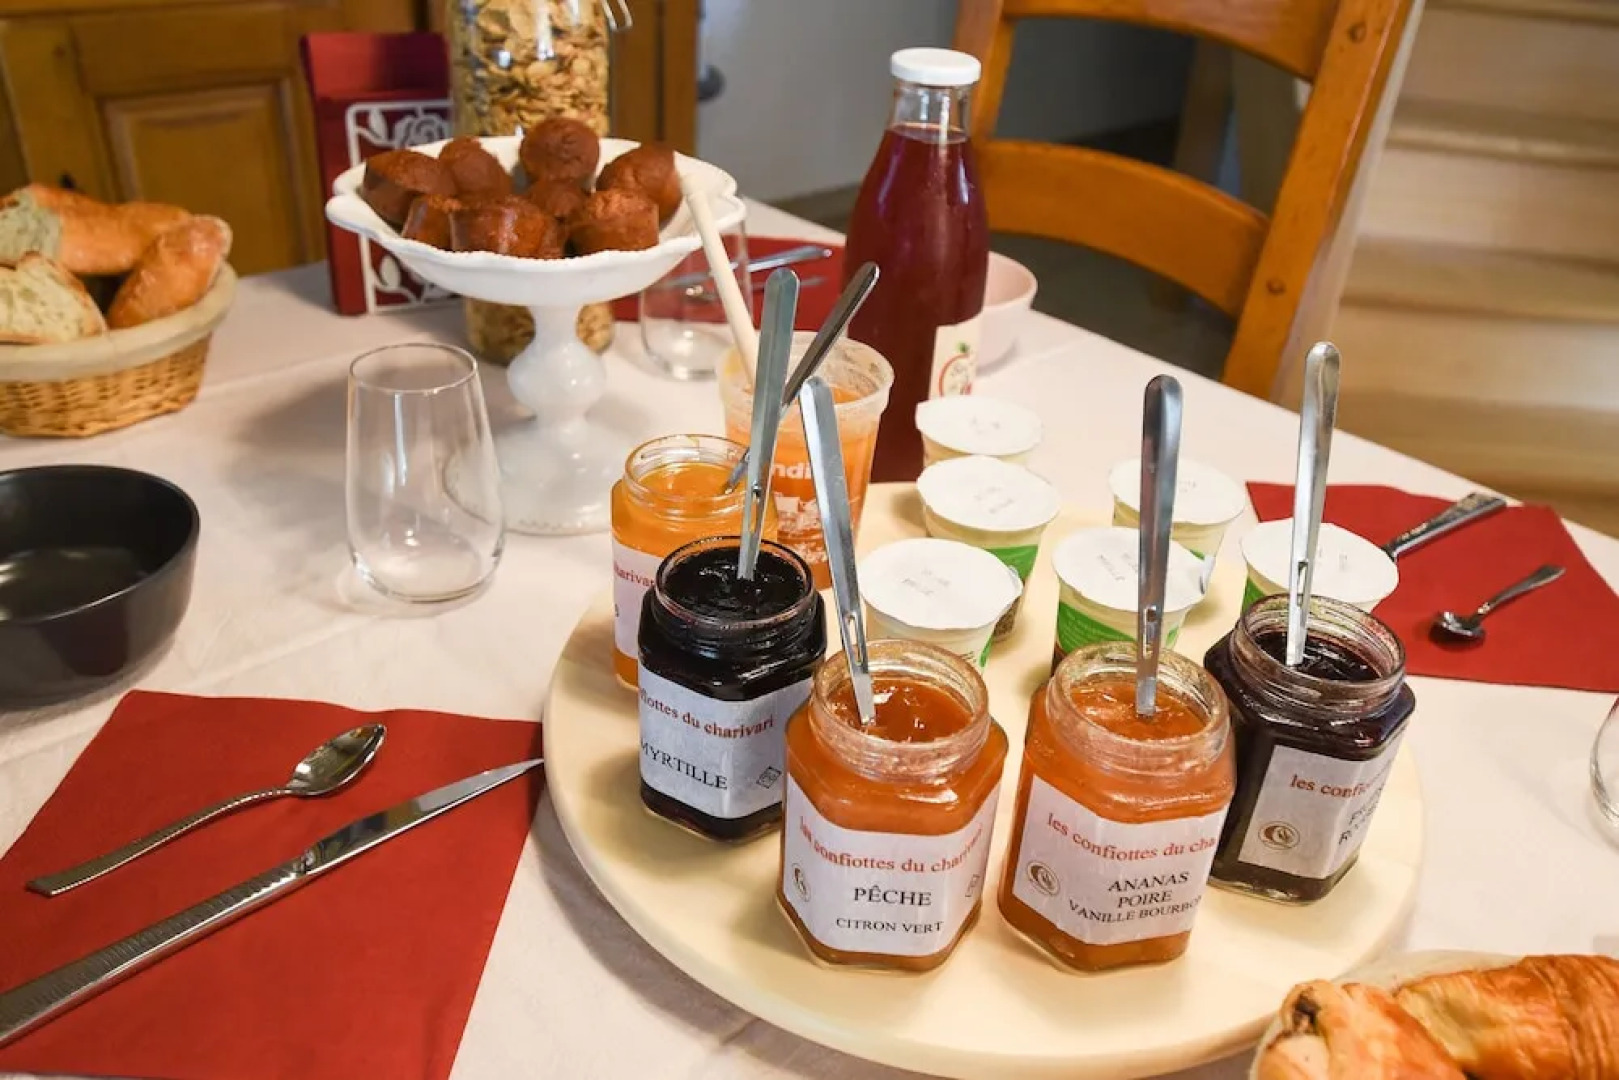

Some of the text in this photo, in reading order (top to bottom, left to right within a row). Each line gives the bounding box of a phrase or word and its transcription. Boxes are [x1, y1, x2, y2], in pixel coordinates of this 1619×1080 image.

[683, 712, 700, 729] du
[704, 714, 773, 738] charivari
[641, 738, 728, 790] MYRTILLE
[1290, 774, 1315, 791] les
[1048, 813, 1069, 835] les
[1073, 833, 1157, 861] confiottes
[1163, 842, 1185, 856] du
[815, 841, 895, 870] confiottes
[901, 858, 925, 873] du
[1108, 871, 1190, 892] ANANAS
[853, 885, 932, 906] PÊCHE
[1117, 891, 1173, 909] POIRE
[1069, 900, 1135, 924] VANILLE
[836, 918, 943, 934] CITRON VERT
